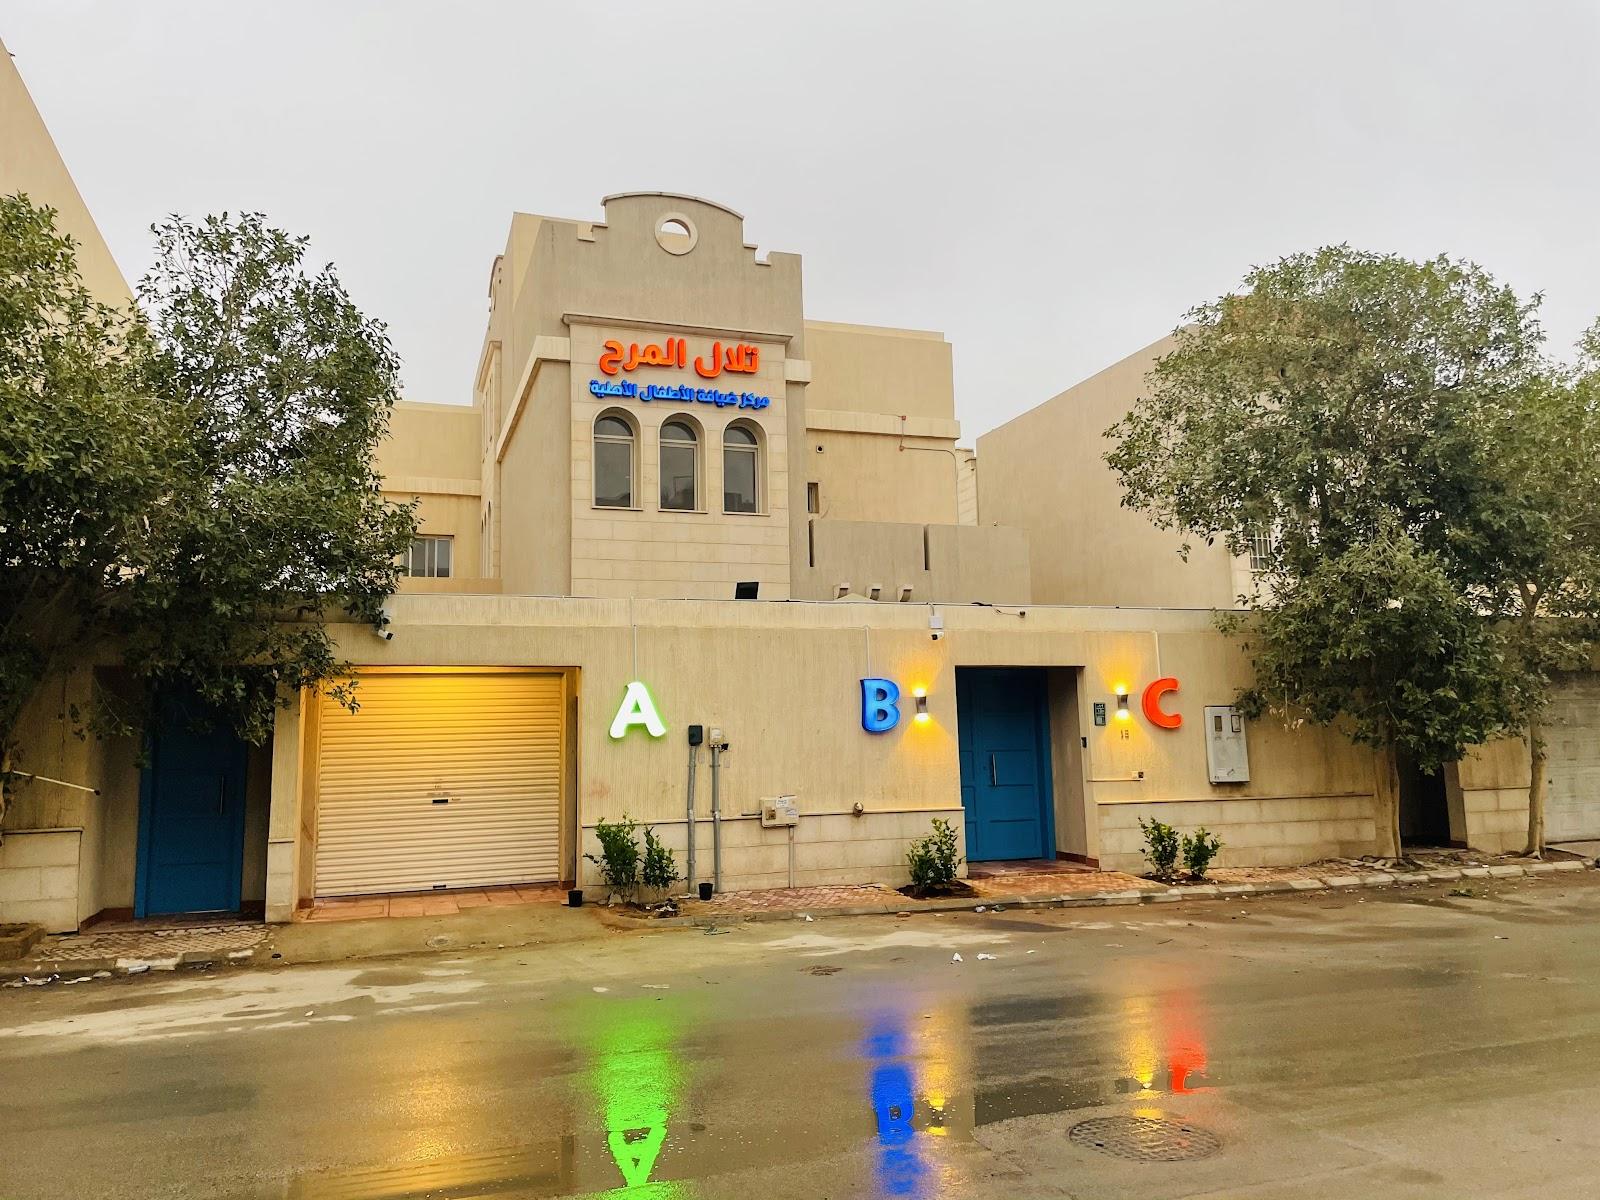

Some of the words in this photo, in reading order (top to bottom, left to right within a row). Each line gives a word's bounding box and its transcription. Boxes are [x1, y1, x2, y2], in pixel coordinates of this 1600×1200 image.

[599, 336, 687, 375] المرح
[694, 341, 759, 379] تلال
[590, 379, 637, 399] الأهلية
[639, 383, 694, 403] الأطفال
[696, 387, 738, 407] ضيافة
[738, 392, 770, 410] مركز
[609, 681, 667, 739] A
[859, 678, 900, 733] B
[1141, 676, 1183, 729] C
